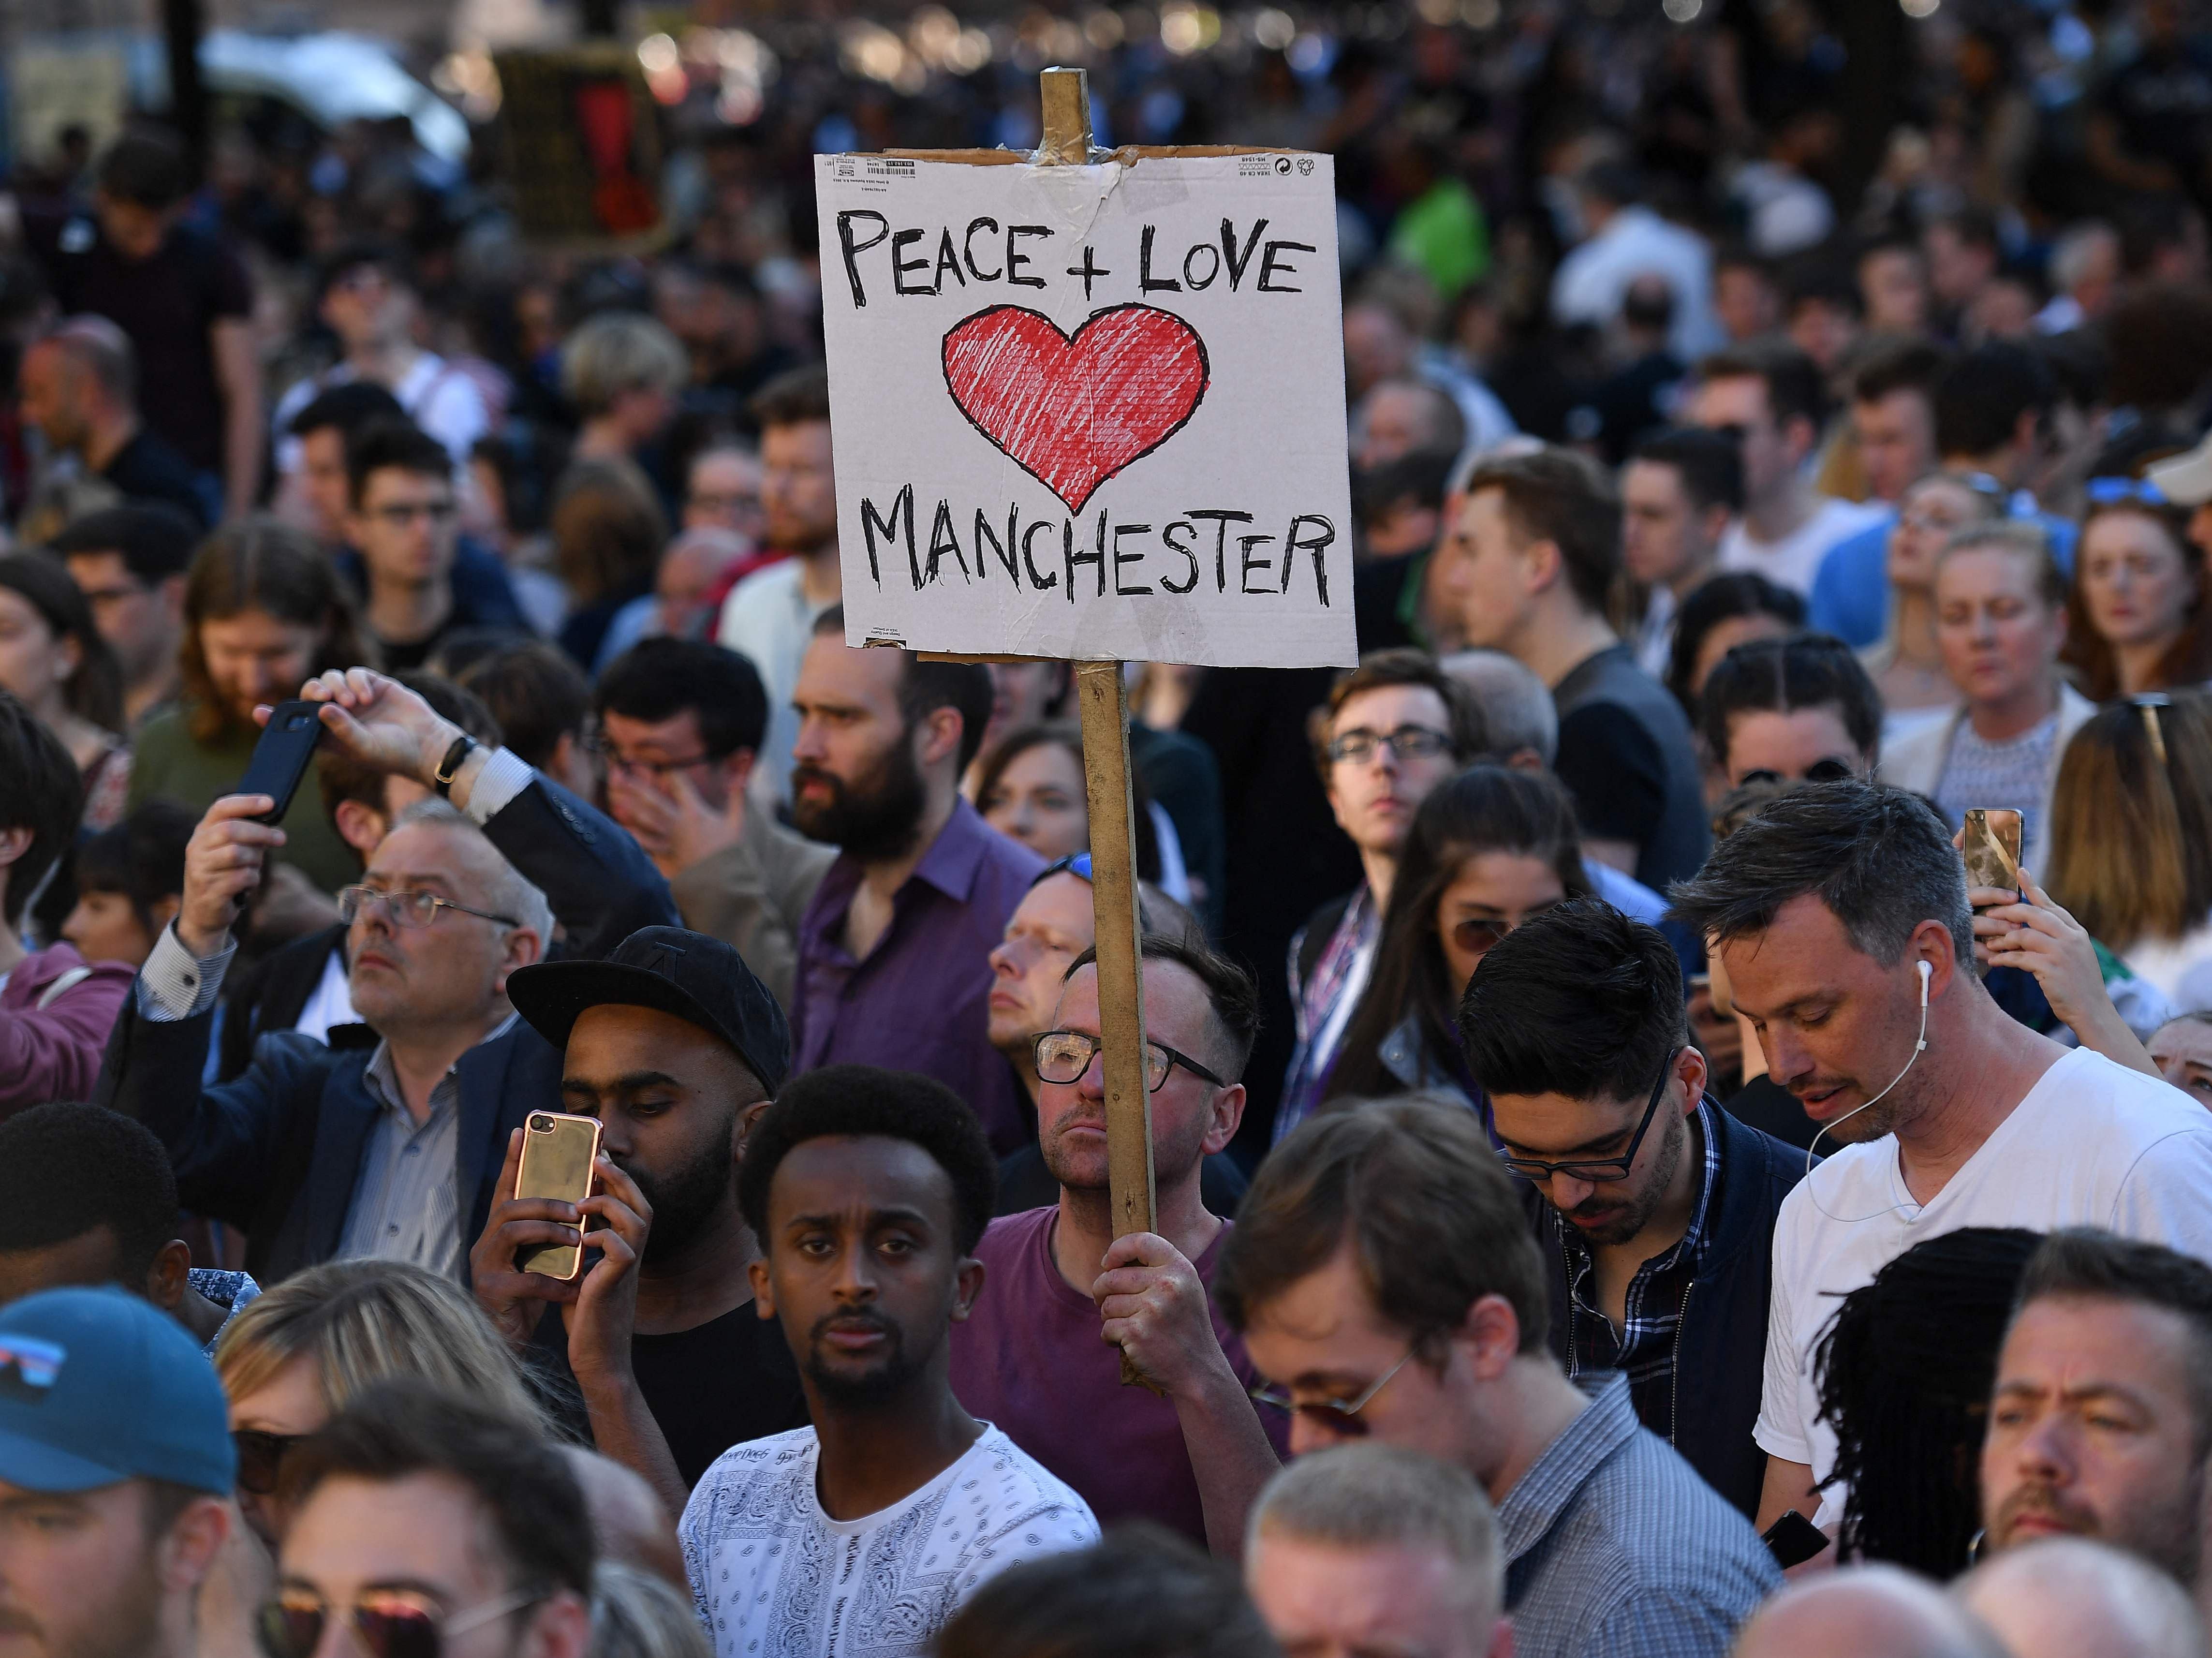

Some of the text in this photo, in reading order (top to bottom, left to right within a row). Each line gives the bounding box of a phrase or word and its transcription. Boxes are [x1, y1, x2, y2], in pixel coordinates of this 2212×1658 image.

[838, 209, 1316, 309] PEACE + LOVE
[860, 484, 1336, 607] MANCHESTER
